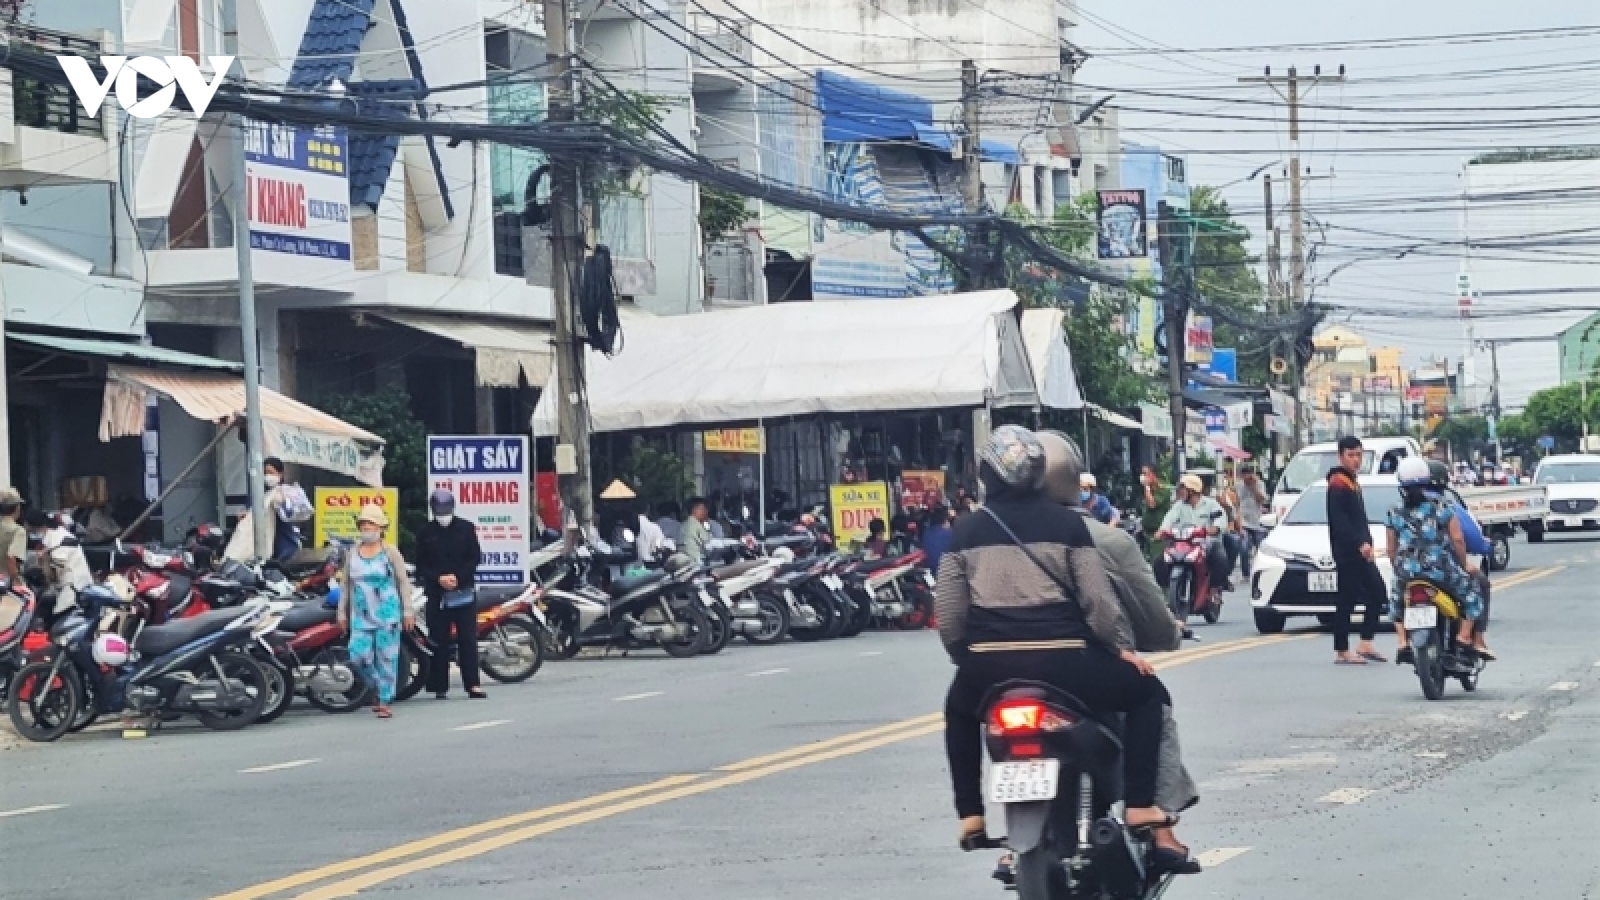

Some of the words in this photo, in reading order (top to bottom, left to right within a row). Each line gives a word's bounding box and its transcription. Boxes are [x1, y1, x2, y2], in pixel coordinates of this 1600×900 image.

[257, 176, 306, 229] KHANG
[482, 439, 520, 470] SẤY
[459, 481, 519, 504] KHANG
